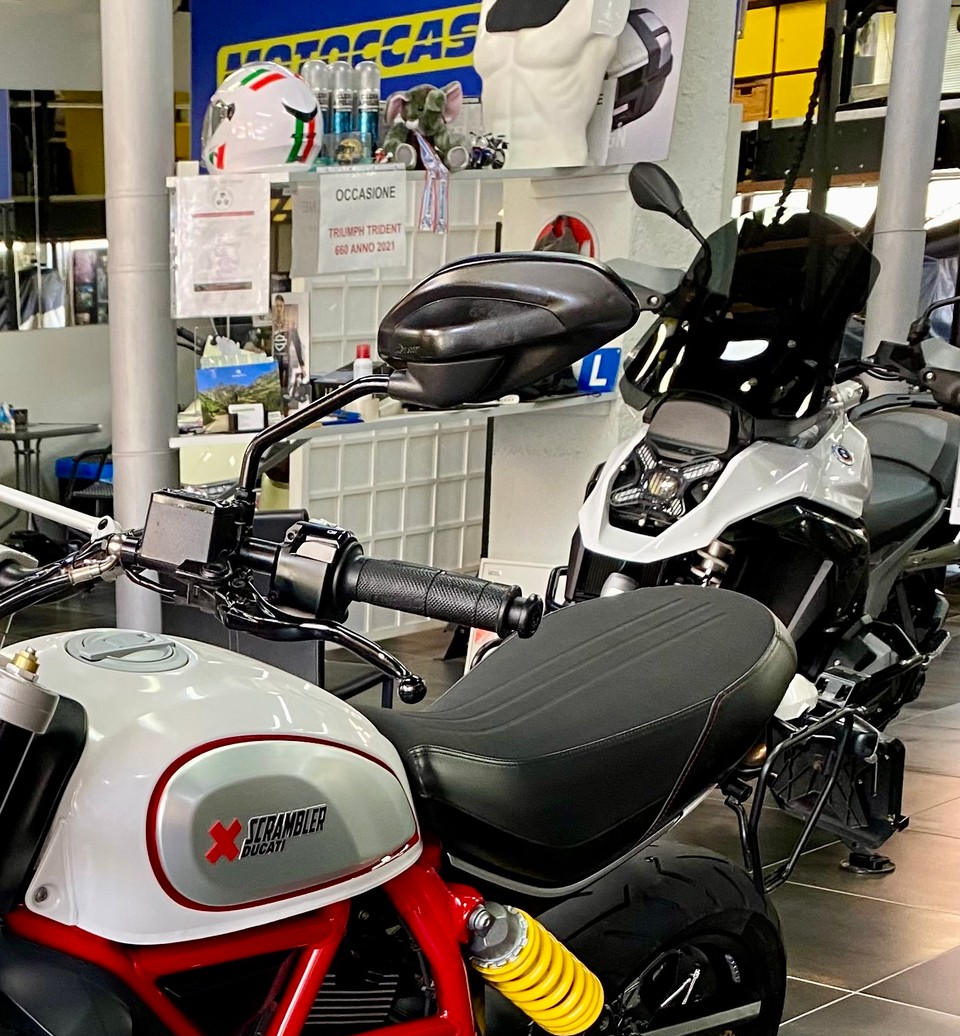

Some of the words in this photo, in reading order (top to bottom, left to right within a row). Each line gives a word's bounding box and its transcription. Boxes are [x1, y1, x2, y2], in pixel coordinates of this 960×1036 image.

[336, 186, 396, 202] OCCASIONE
[328, 226, 365, 238] TRIUMPH
[367, 223, 401, 236] TRIDENT
[334, 244, 349, 256] 660
[350, 242, 375, 254] ANNO
[376, 240, 395, 252] 2021
[588, 354, 607, 387] L
[244, 804, 327, 845] SCRAMBLER
[240, 840, 286, 859] DUCATI
